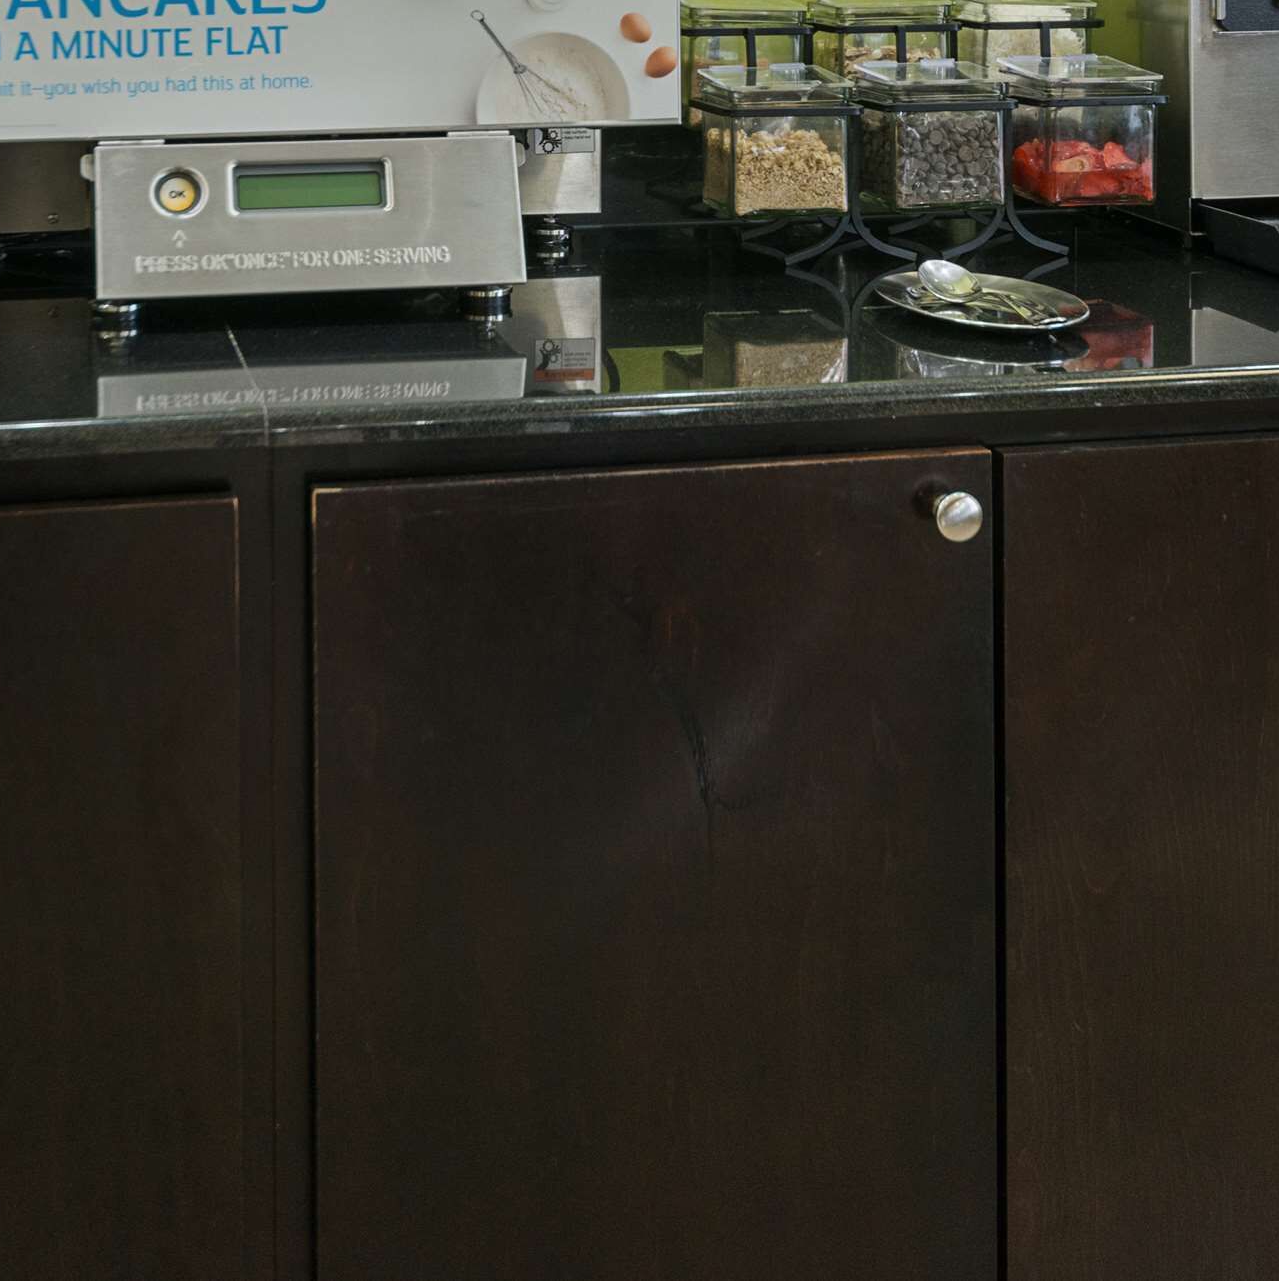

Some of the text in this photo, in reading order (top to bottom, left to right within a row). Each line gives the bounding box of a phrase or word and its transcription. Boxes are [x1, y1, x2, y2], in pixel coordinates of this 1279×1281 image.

[14, 31, 40, 61] A
[51, 27, 194, 60] MINUTE
[205, 25, 289, 56] FLAT
[81, 78, 121, 95] wish
[126, 79, 160, 97] you
[165, 76, 198, 93] had
[202, 75, 234, 91] this
[239, 76, 256, 90] at
[261, 74, 314, 90] home.
[169, 189, 187, 199] OK
[136, 254, 199, 273] PRESS
[201, 253, 227, 270] OK
[293, 251, 331, 268] FOR
[334, 248, 371, 266] ONE
[373, 245, 451, 264] SERVING
